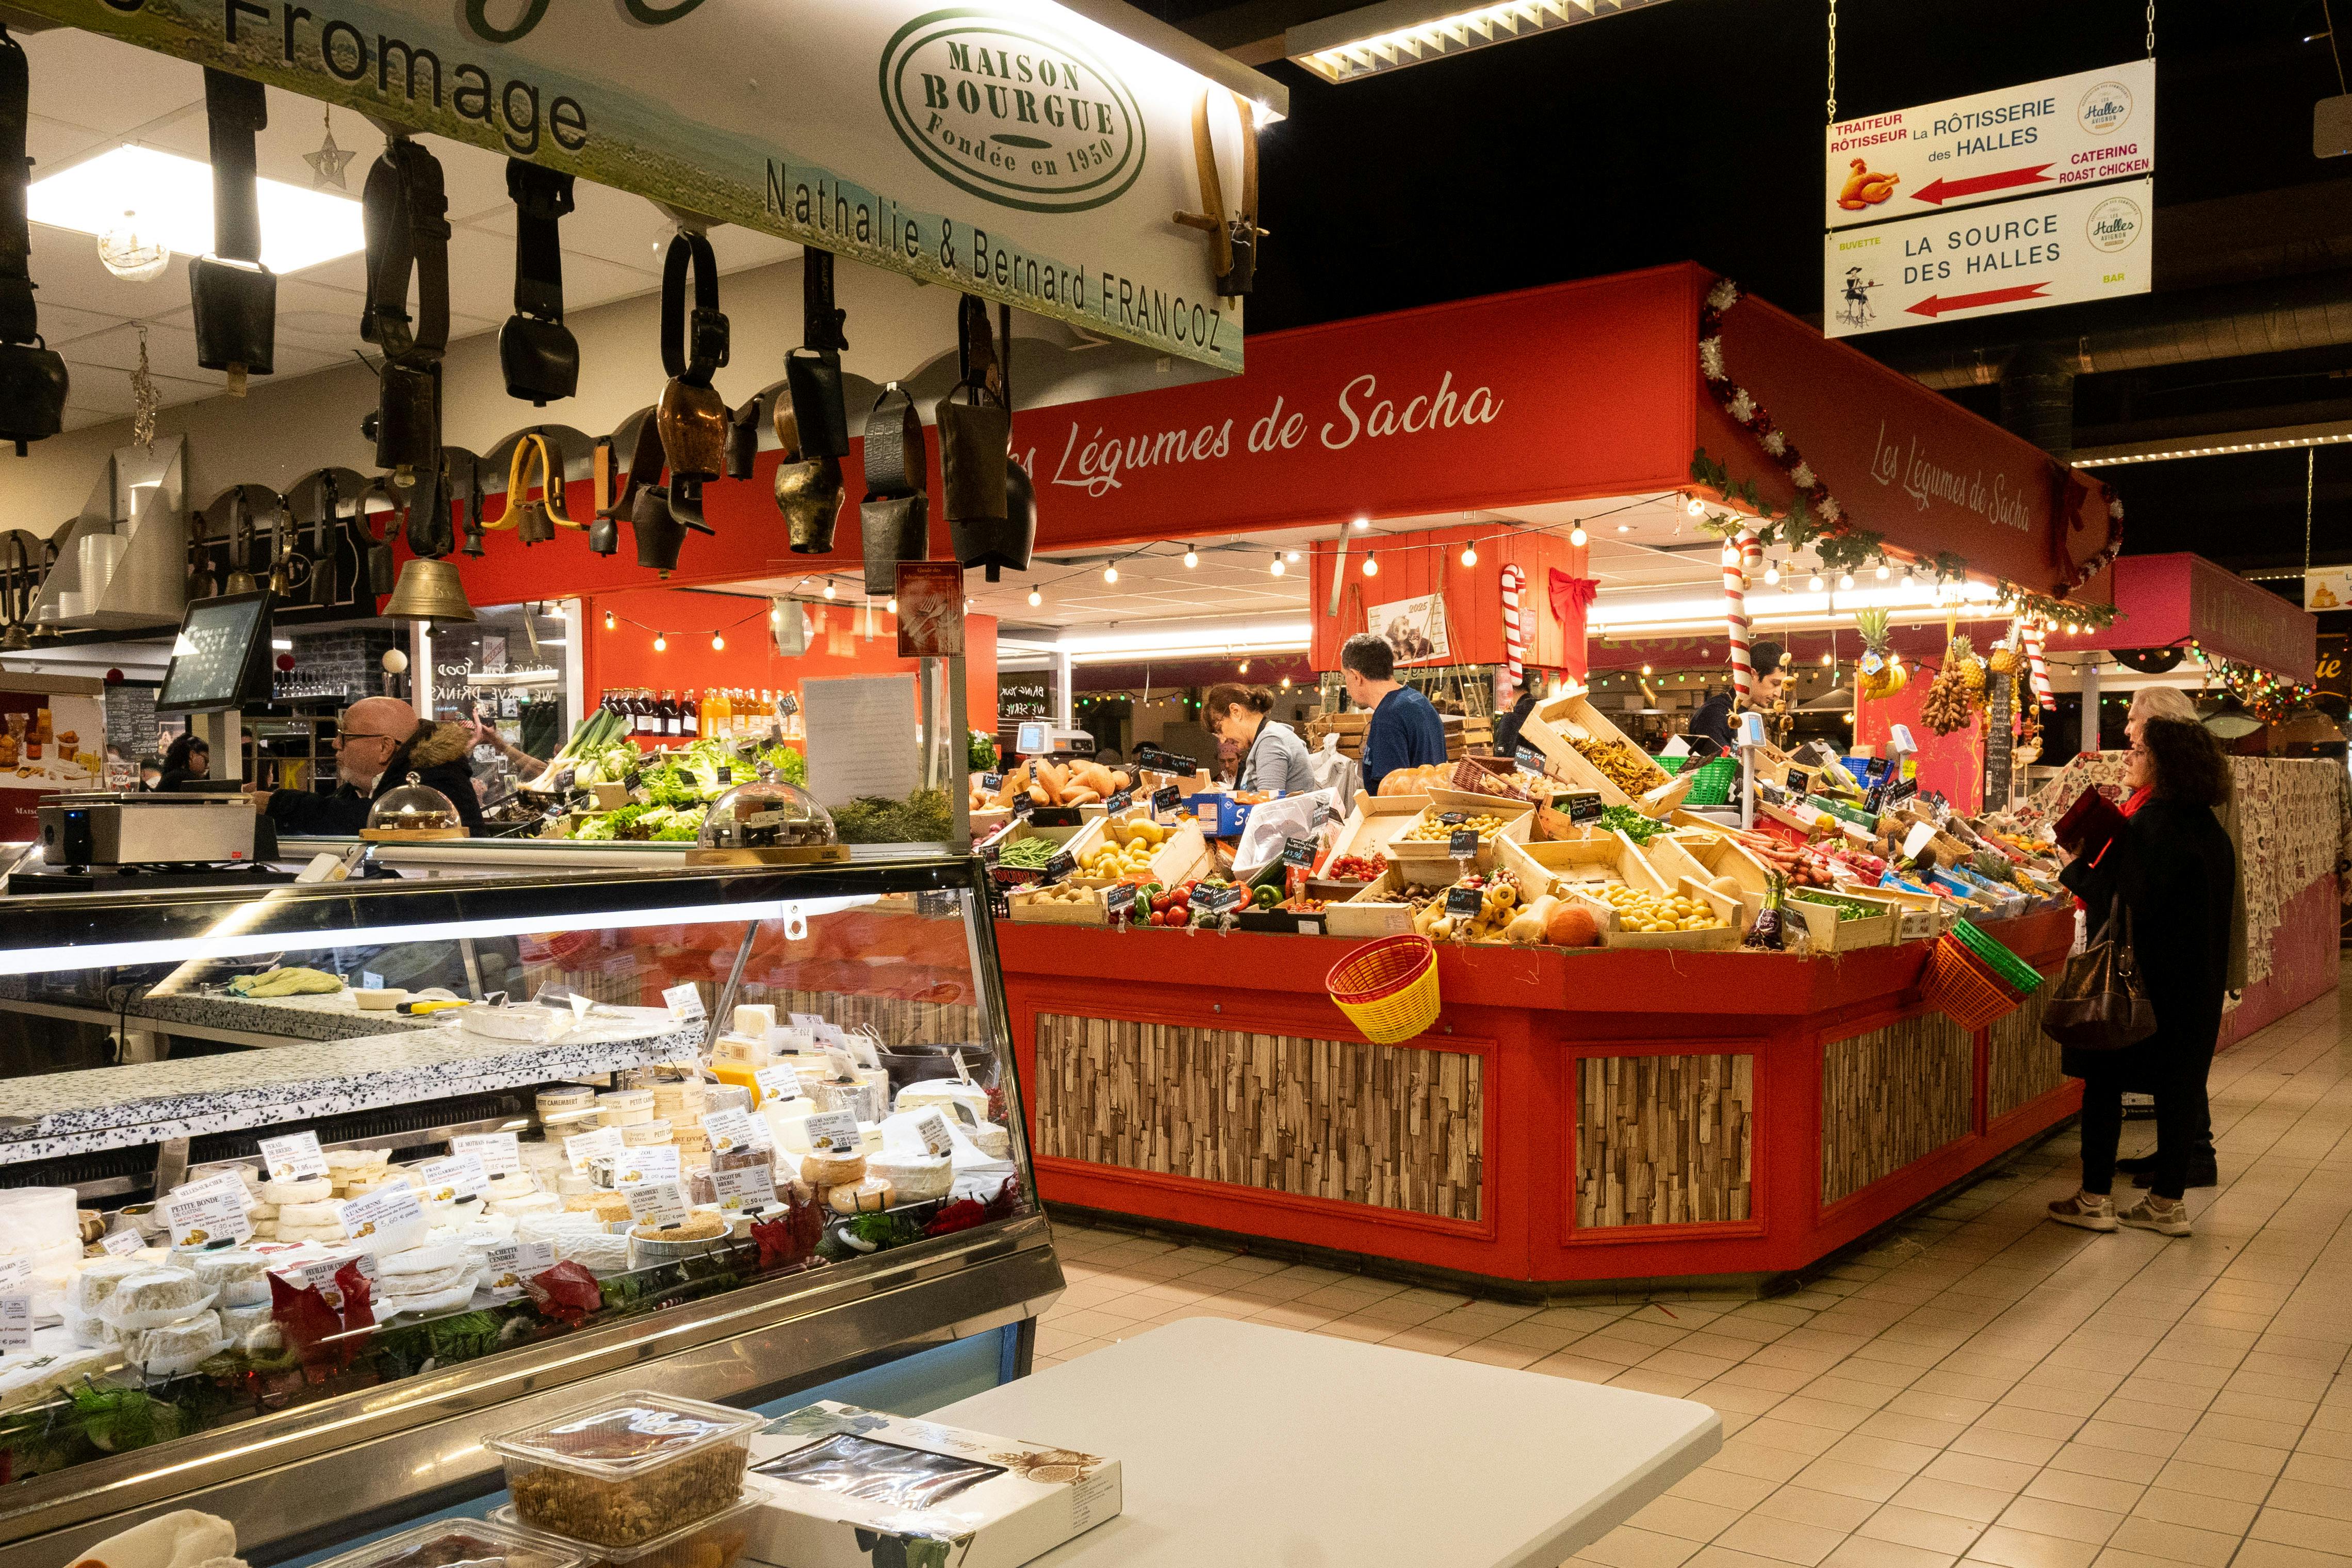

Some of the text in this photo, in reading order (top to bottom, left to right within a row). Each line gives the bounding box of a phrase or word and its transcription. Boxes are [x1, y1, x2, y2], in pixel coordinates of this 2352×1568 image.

[946, 41, 1079, 91] MAISON
[225, 0, 587, 155] Fromage
[921, 73, 1114, 135] BOURGUE
[2084, 102, 2125, 119] Halles
[1835, 113, 1903, 136] TRAITEUR
[1913, 97, 2056, 141] La RÔTISSERIE
[2092, 115, 2116, 124] AVIGNON
[926, 111, 1114, 175] Fondée en 1950
[1831, 128, 1907, 153] RÔTISSEUR
[1928, 126, 2038, 162] des HALLES
[2070, 143, 2138, 166] CATERING
[2059, 158, 2149, 184] ROAST CHICKEN
[2093, 218, 2134, 235] Halles
[1839, 236, 1881, 250] BUVETTE
[1905, 215, 2058, 257] LA SOURCE
[2101, 232, 2126, 241] AVIGNON
[766, 158, 1221, 353] Nathalie & Bernard FRANCOZ
[1904, 242, 2061, 285] DES HALLES
[2103, 273, 2125, 284] BAR
[1052, 419, 1234, 497] Légumes
[1248, 396, 1308, 453] de
[1321, 371, 1505, 449] Sacha
[1871, 419, 2029, 532] Les Légumes de Sacha
[1409, 602, 1428, 613] 2025
[181, 1179, 223, 1197] SELLES-SUR-CHER
[630, 1189, 659, 1198] CAMEMBERT
[171, 1196, 220, 1213] PETITE BONDE
[182, 1207, 202, 1216] GATINE
[343, 1202, 359, 1211] TOME
[350, 1199, 382, 1217] L'ANCIENNE
[378, 1212, 393, 1220] Maison
[399, 1202, 416, 1211] Fromage
[389, 1201, 406, 1210] Provence
[381, 1217, 398, 1227] 5,60
[405, 1209, 419, 1218] pièce
[212, 1223, 227, 1233] 7,90
[305, 1265, 328, 1276] FEUILLE
